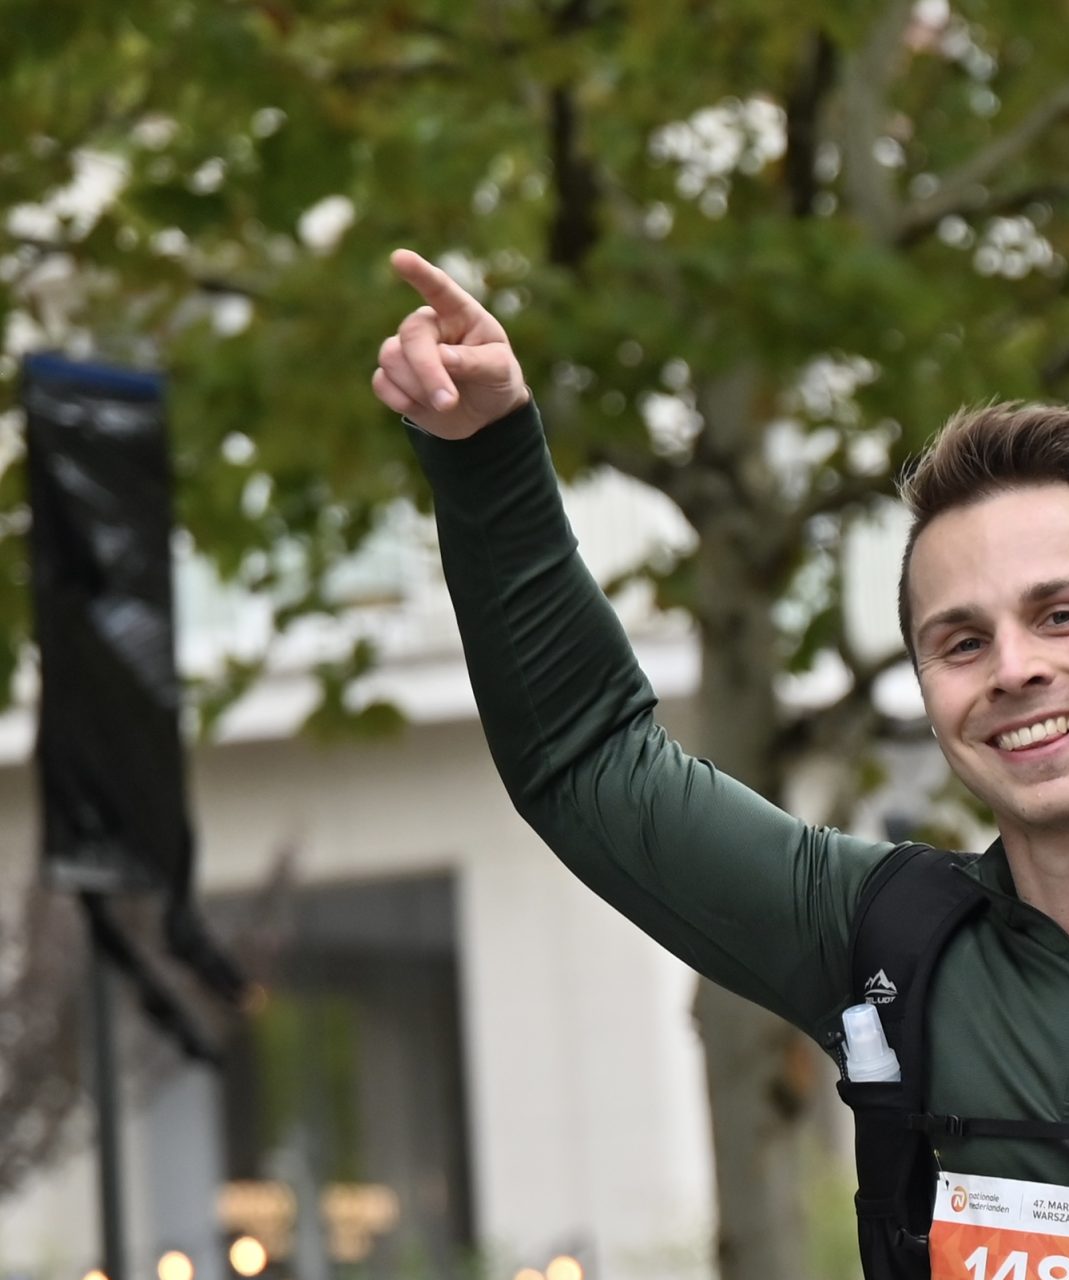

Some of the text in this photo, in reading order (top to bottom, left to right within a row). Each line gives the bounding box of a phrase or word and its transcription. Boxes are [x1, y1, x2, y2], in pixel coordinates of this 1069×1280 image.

[969, 1192, 999, 1203] nationale
[969, 1203, 1009, 1214] nederlanden
[1033, 1200, 1046, 1209] 47.
